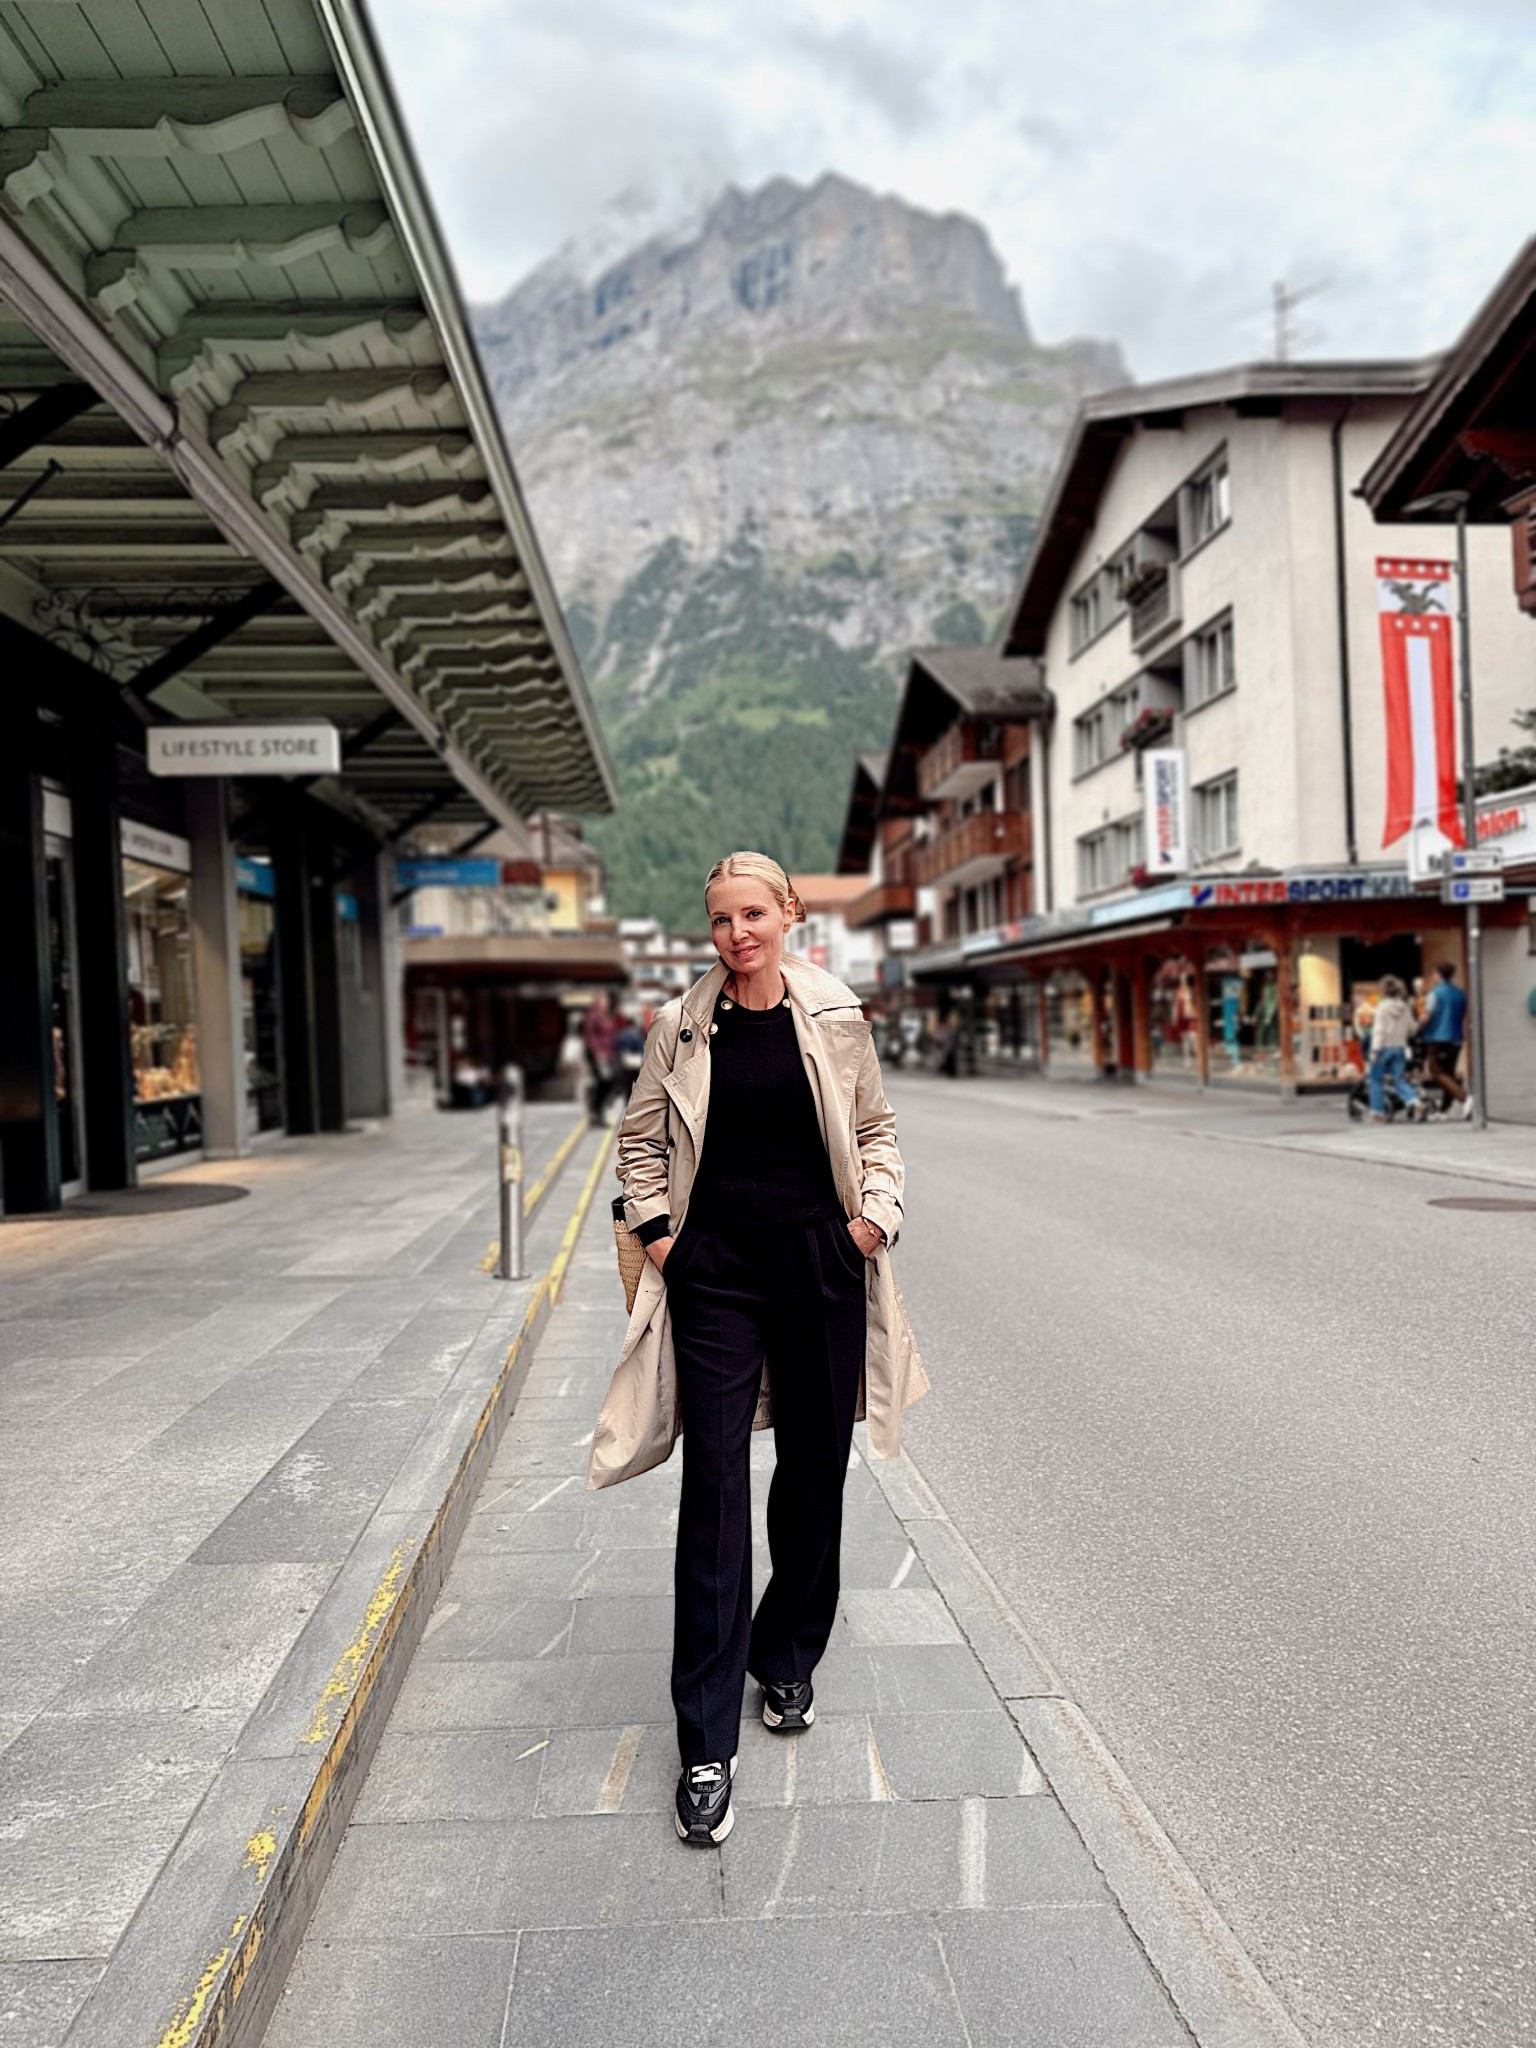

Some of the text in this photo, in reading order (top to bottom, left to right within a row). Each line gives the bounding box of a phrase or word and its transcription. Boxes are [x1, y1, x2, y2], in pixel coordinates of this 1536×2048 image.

[161, 738, 318, 757] LIFESTYLE STORE
[1215, 878, 1366, 904] INTERSPORT
